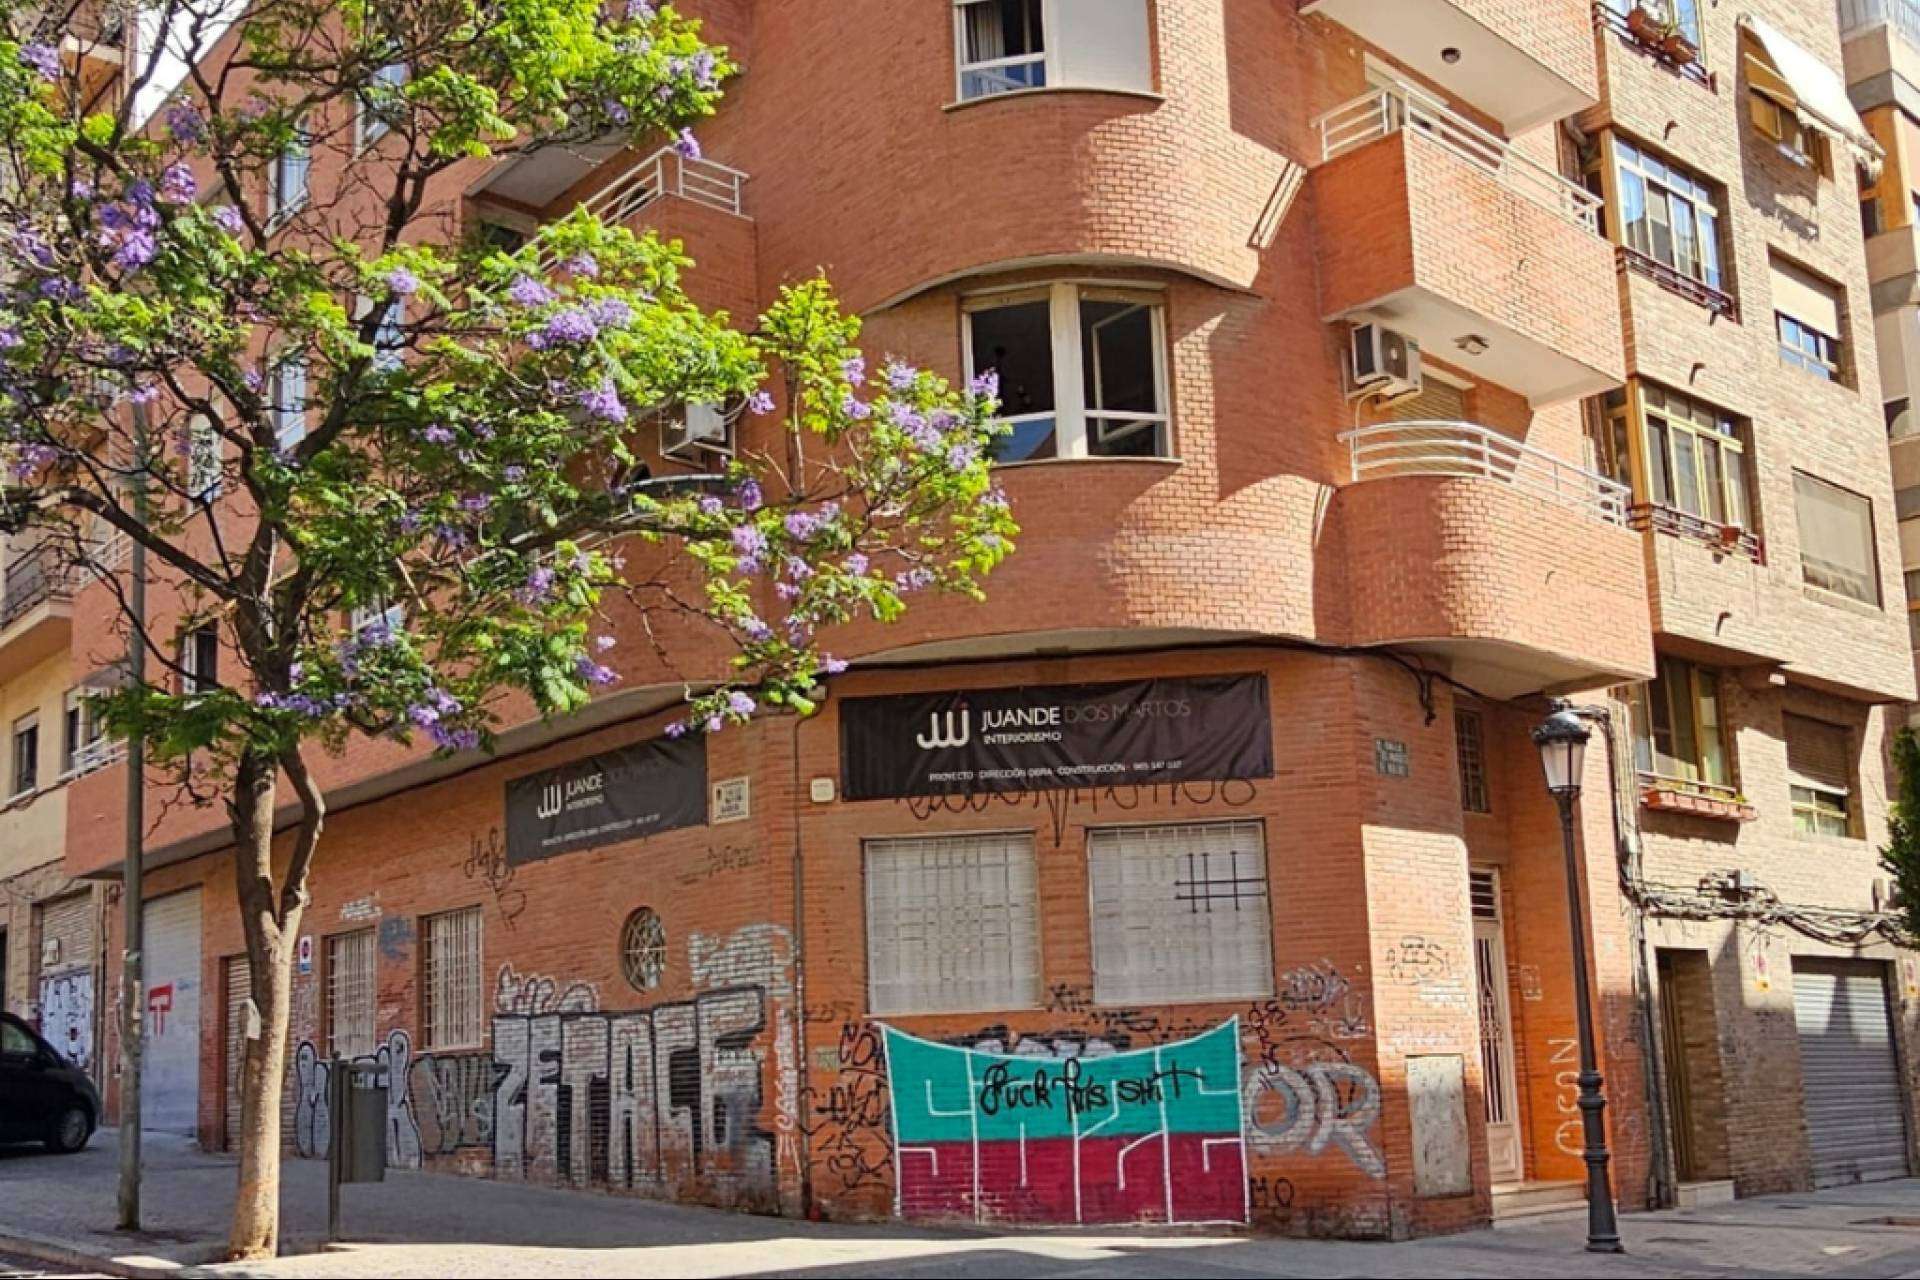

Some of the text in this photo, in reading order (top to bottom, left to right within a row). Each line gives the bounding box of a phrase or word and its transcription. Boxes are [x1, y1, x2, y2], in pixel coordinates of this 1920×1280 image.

[981, 706, 1061, 732] JUANDE
[1064, 704, 1110, 722] DOS
[984, 731, 1062, 744] INTERIORISMO
[929, 771, 974, 782] PROYECTO
